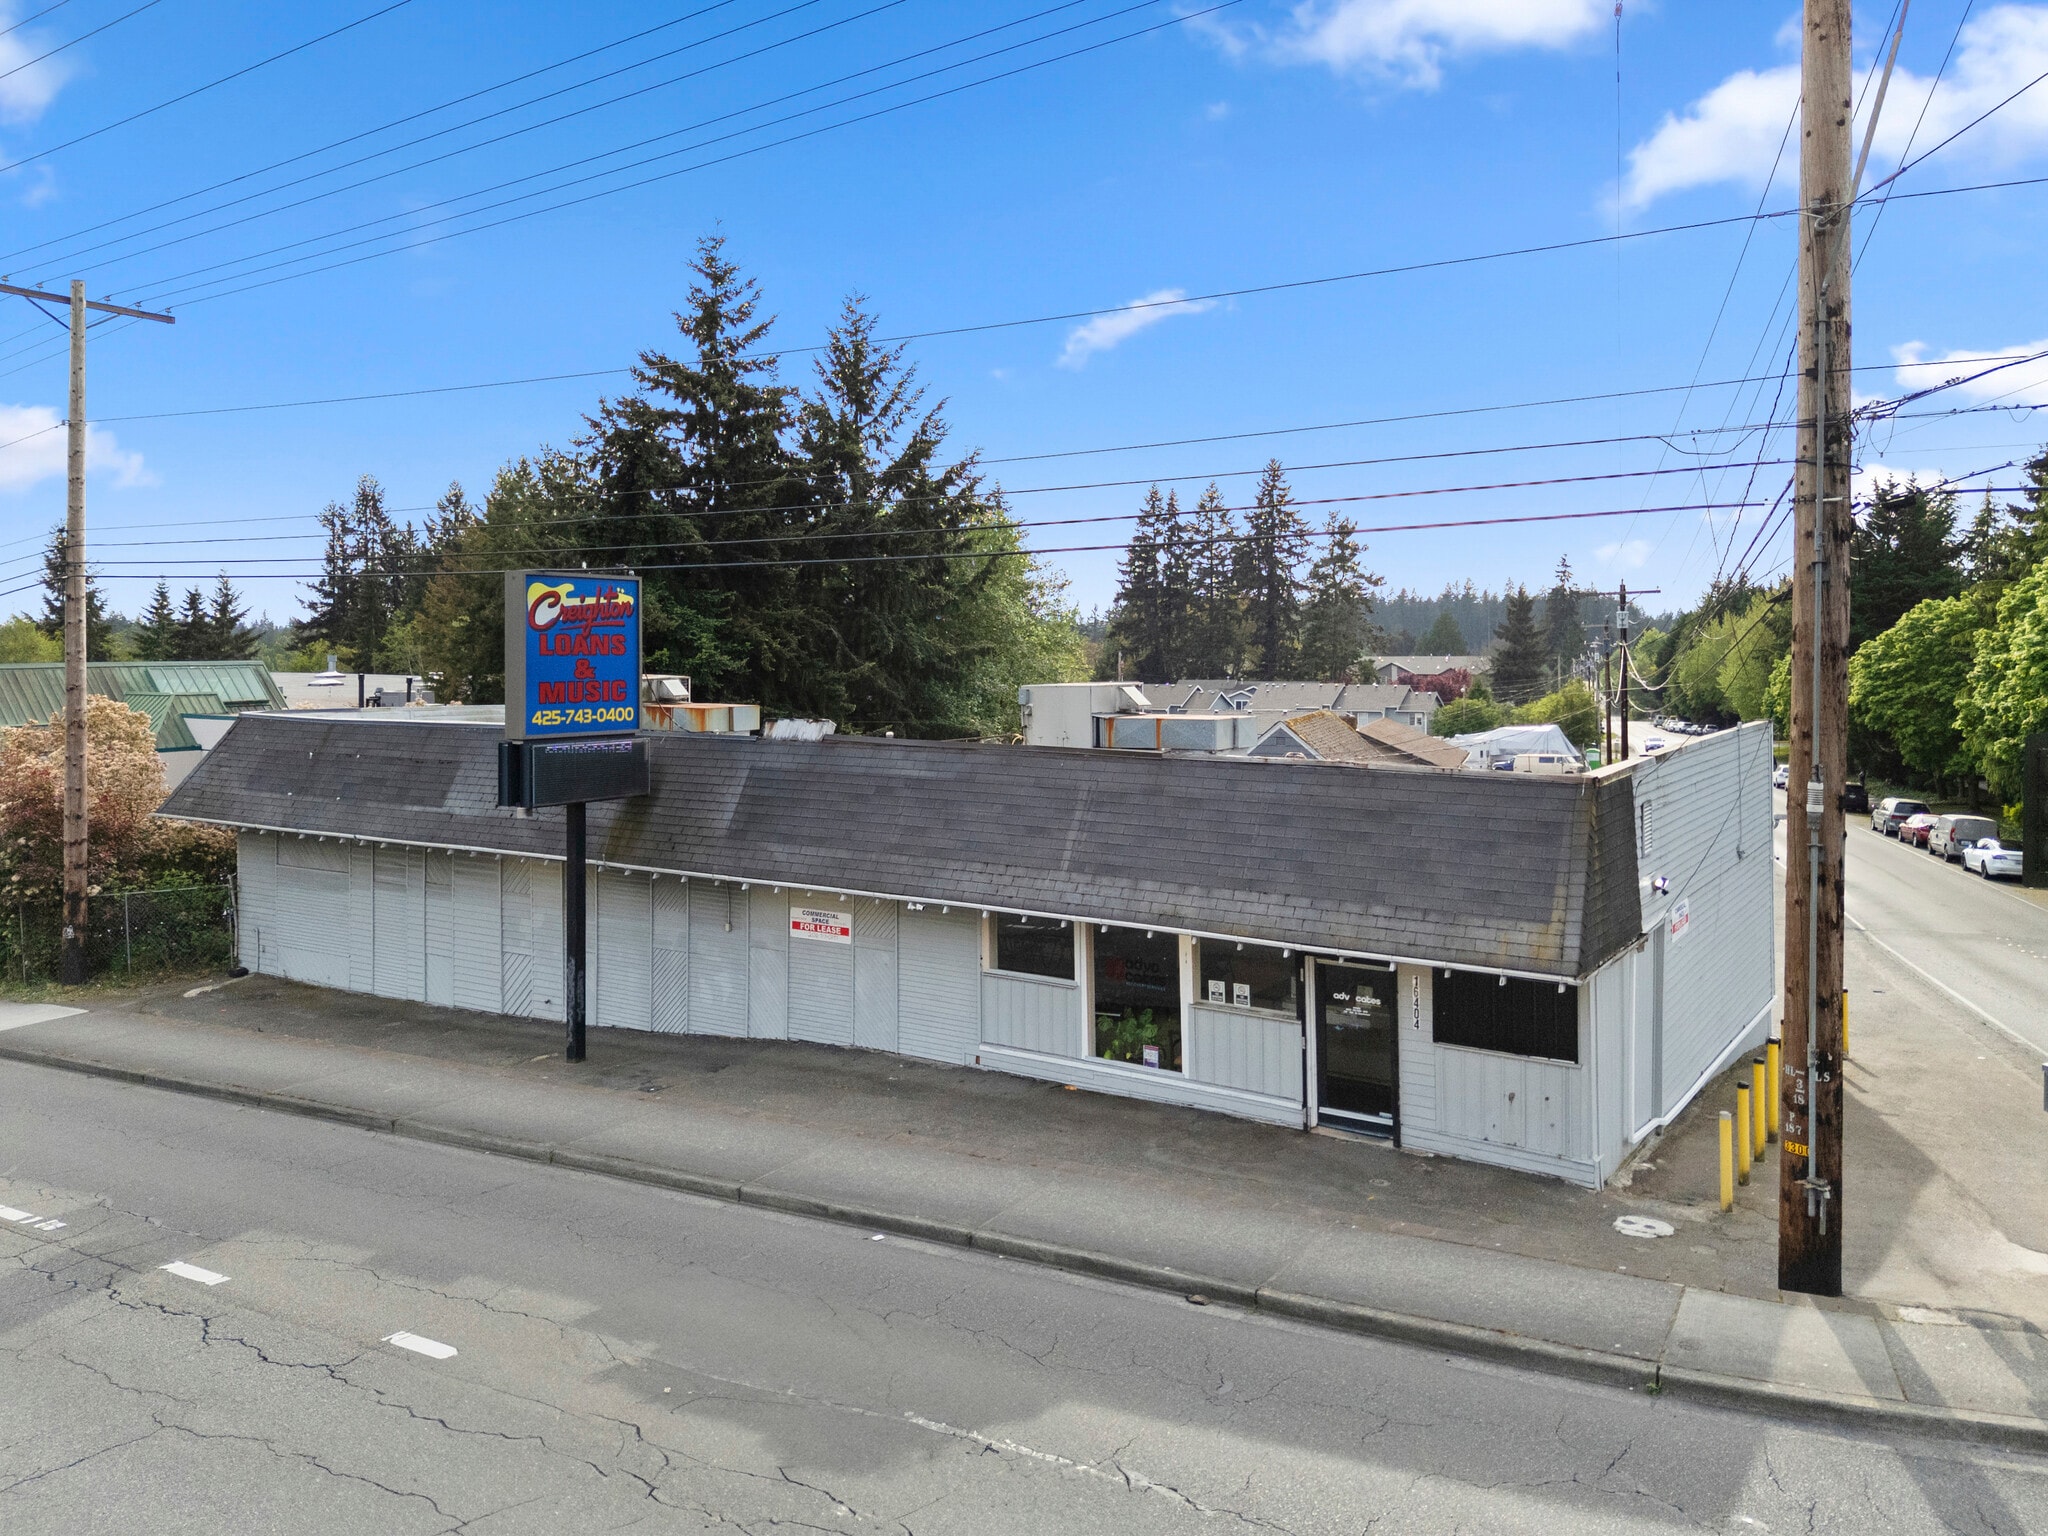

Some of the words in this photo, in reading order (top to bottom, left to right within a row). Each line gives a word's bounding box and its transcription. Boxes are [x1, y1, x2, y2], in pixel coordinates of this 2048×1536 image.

[529, 586, 634, 637] Creighton
[539, 634, 626, 656] LOANS
[574, 659, 596, 679] &
[539, 680, 626, 704] MUSIC
[532, 708, 634, 725] 425-743-0400
[802, 910, 839, 919] COMMERCIAL
[801, 923, 815, 931] FOR
[817, 925, 841, 934] LEASE
[1412, 976, 1420, 1030] 16404
